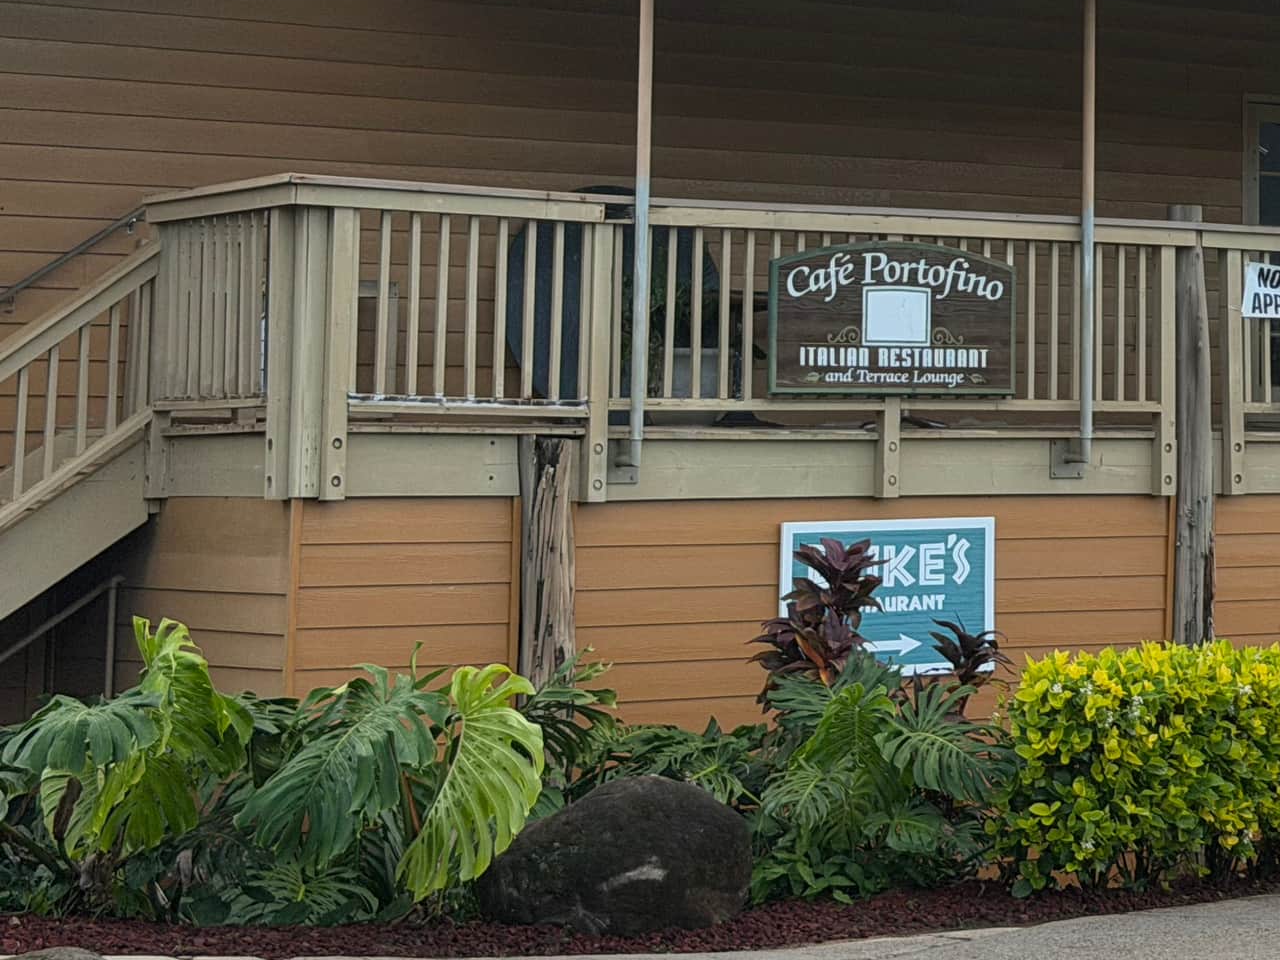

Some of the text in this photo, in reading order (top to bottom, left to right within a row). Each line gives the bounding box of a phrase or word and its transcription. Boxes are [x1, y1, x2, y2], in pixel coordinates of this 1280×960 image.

[786, 252, 1004, 302] Café Portofino
[800, 346, 989, 368] ITALIAN RESTAURANT
[825, 368, 965, 387] and Terrace Lounge
